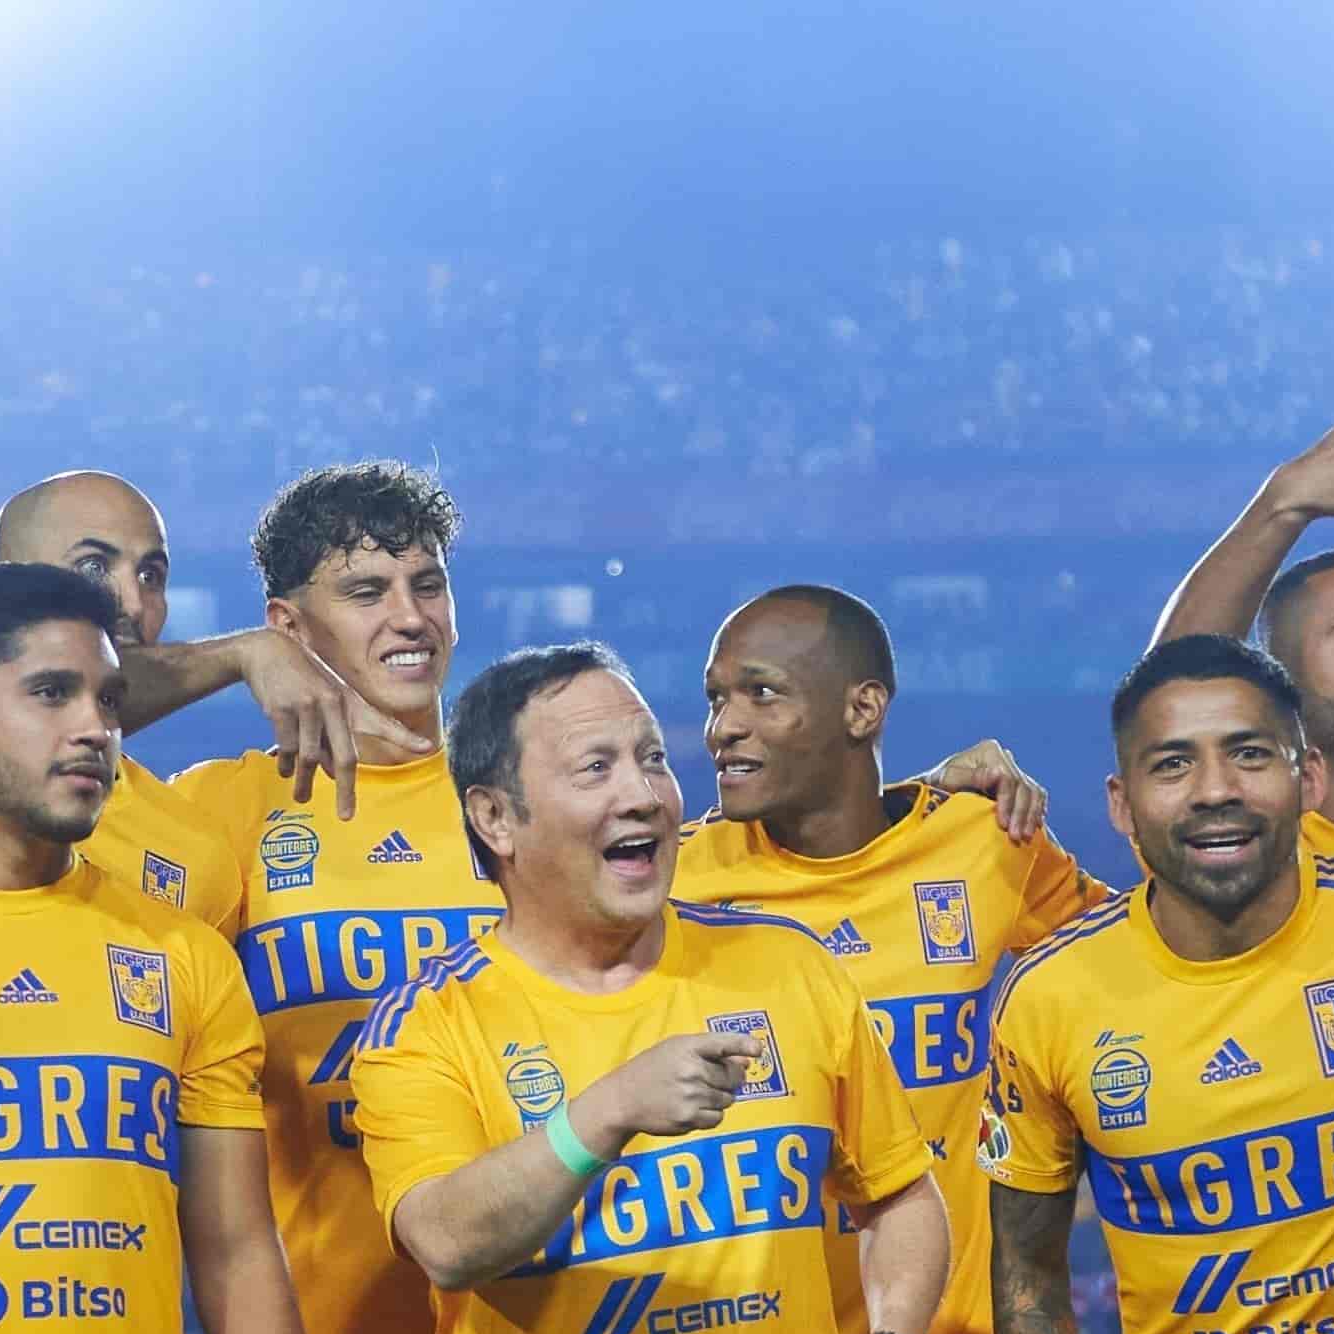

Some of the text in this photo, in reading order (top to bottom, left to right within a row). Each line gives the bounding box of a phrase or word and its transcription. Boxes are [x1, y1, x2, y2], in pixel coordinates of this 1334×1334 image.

[367, 849, 423, 865] adidas
[269, 873, 312, 890] EXTRA
[255, 913, 501, 1003] TIGR
[712, 1015, 766, 1034] TIGRES
[1200, 1060, 1262, 1085] adidas
[1101, 1110, 1143, 1127] EXTRA
[533, 1133, 810, 1264] IGRES
[14, 1220, 147, 1251] CEMEX
[22, 1275, 126, 1319] Bitso
